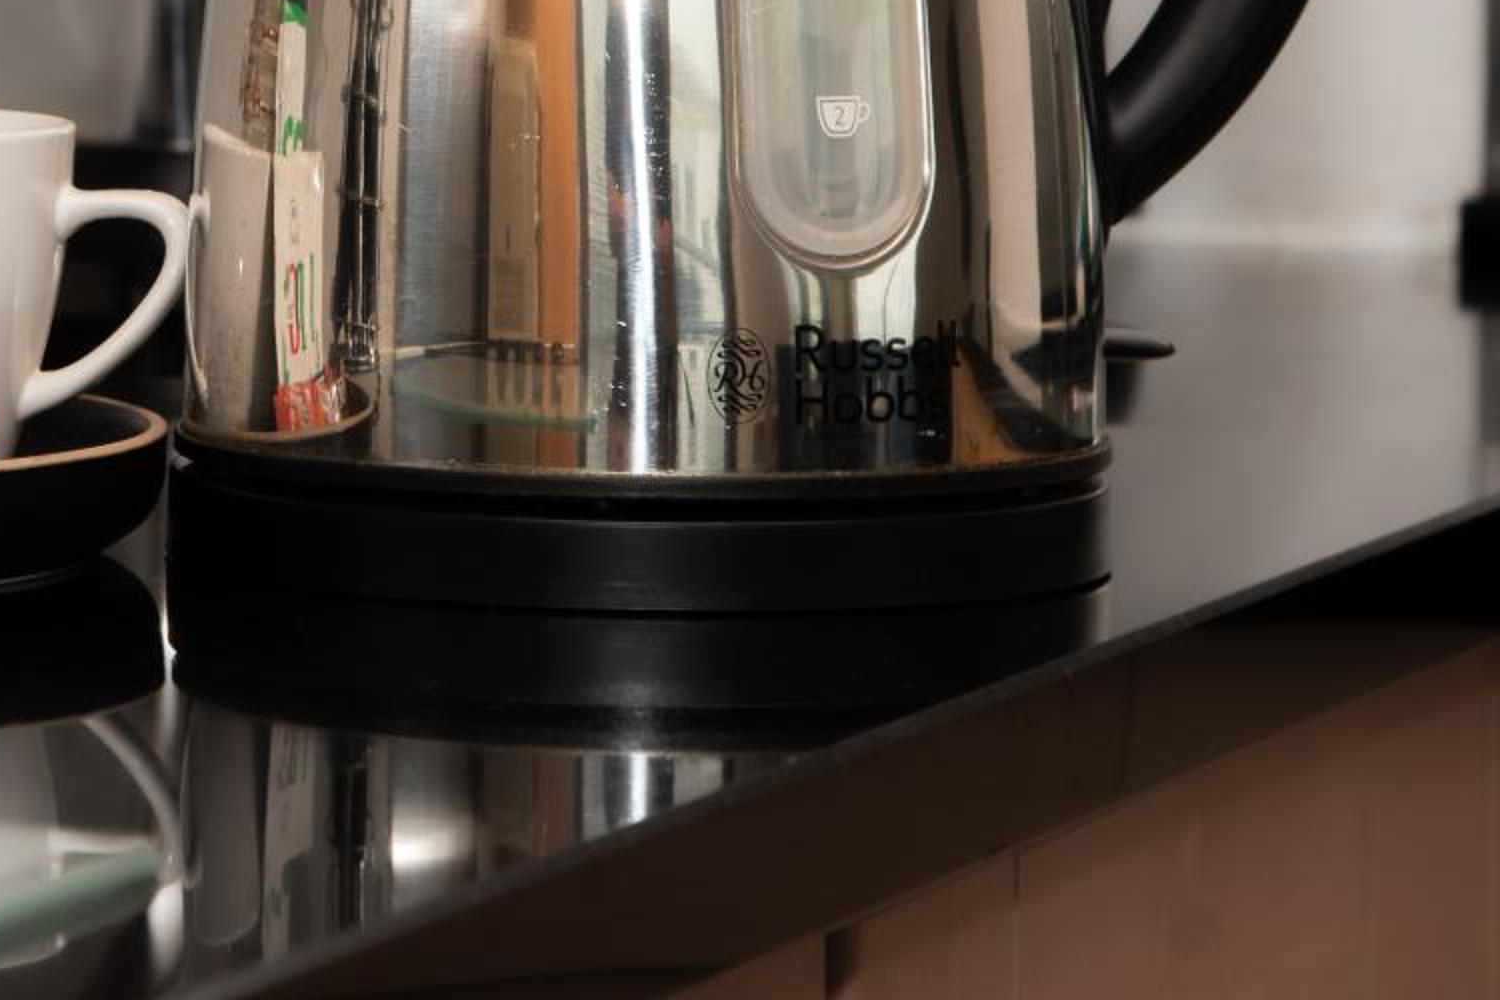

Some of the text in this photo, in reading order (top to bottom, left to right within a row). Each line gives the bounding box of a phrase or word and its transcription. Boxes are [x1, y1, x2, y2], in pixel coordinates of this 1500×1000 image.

[834, 105, 846, 126] 2
[795, 320, 960, 373] Russell
[795, 375, 948, 424] Hobbs
